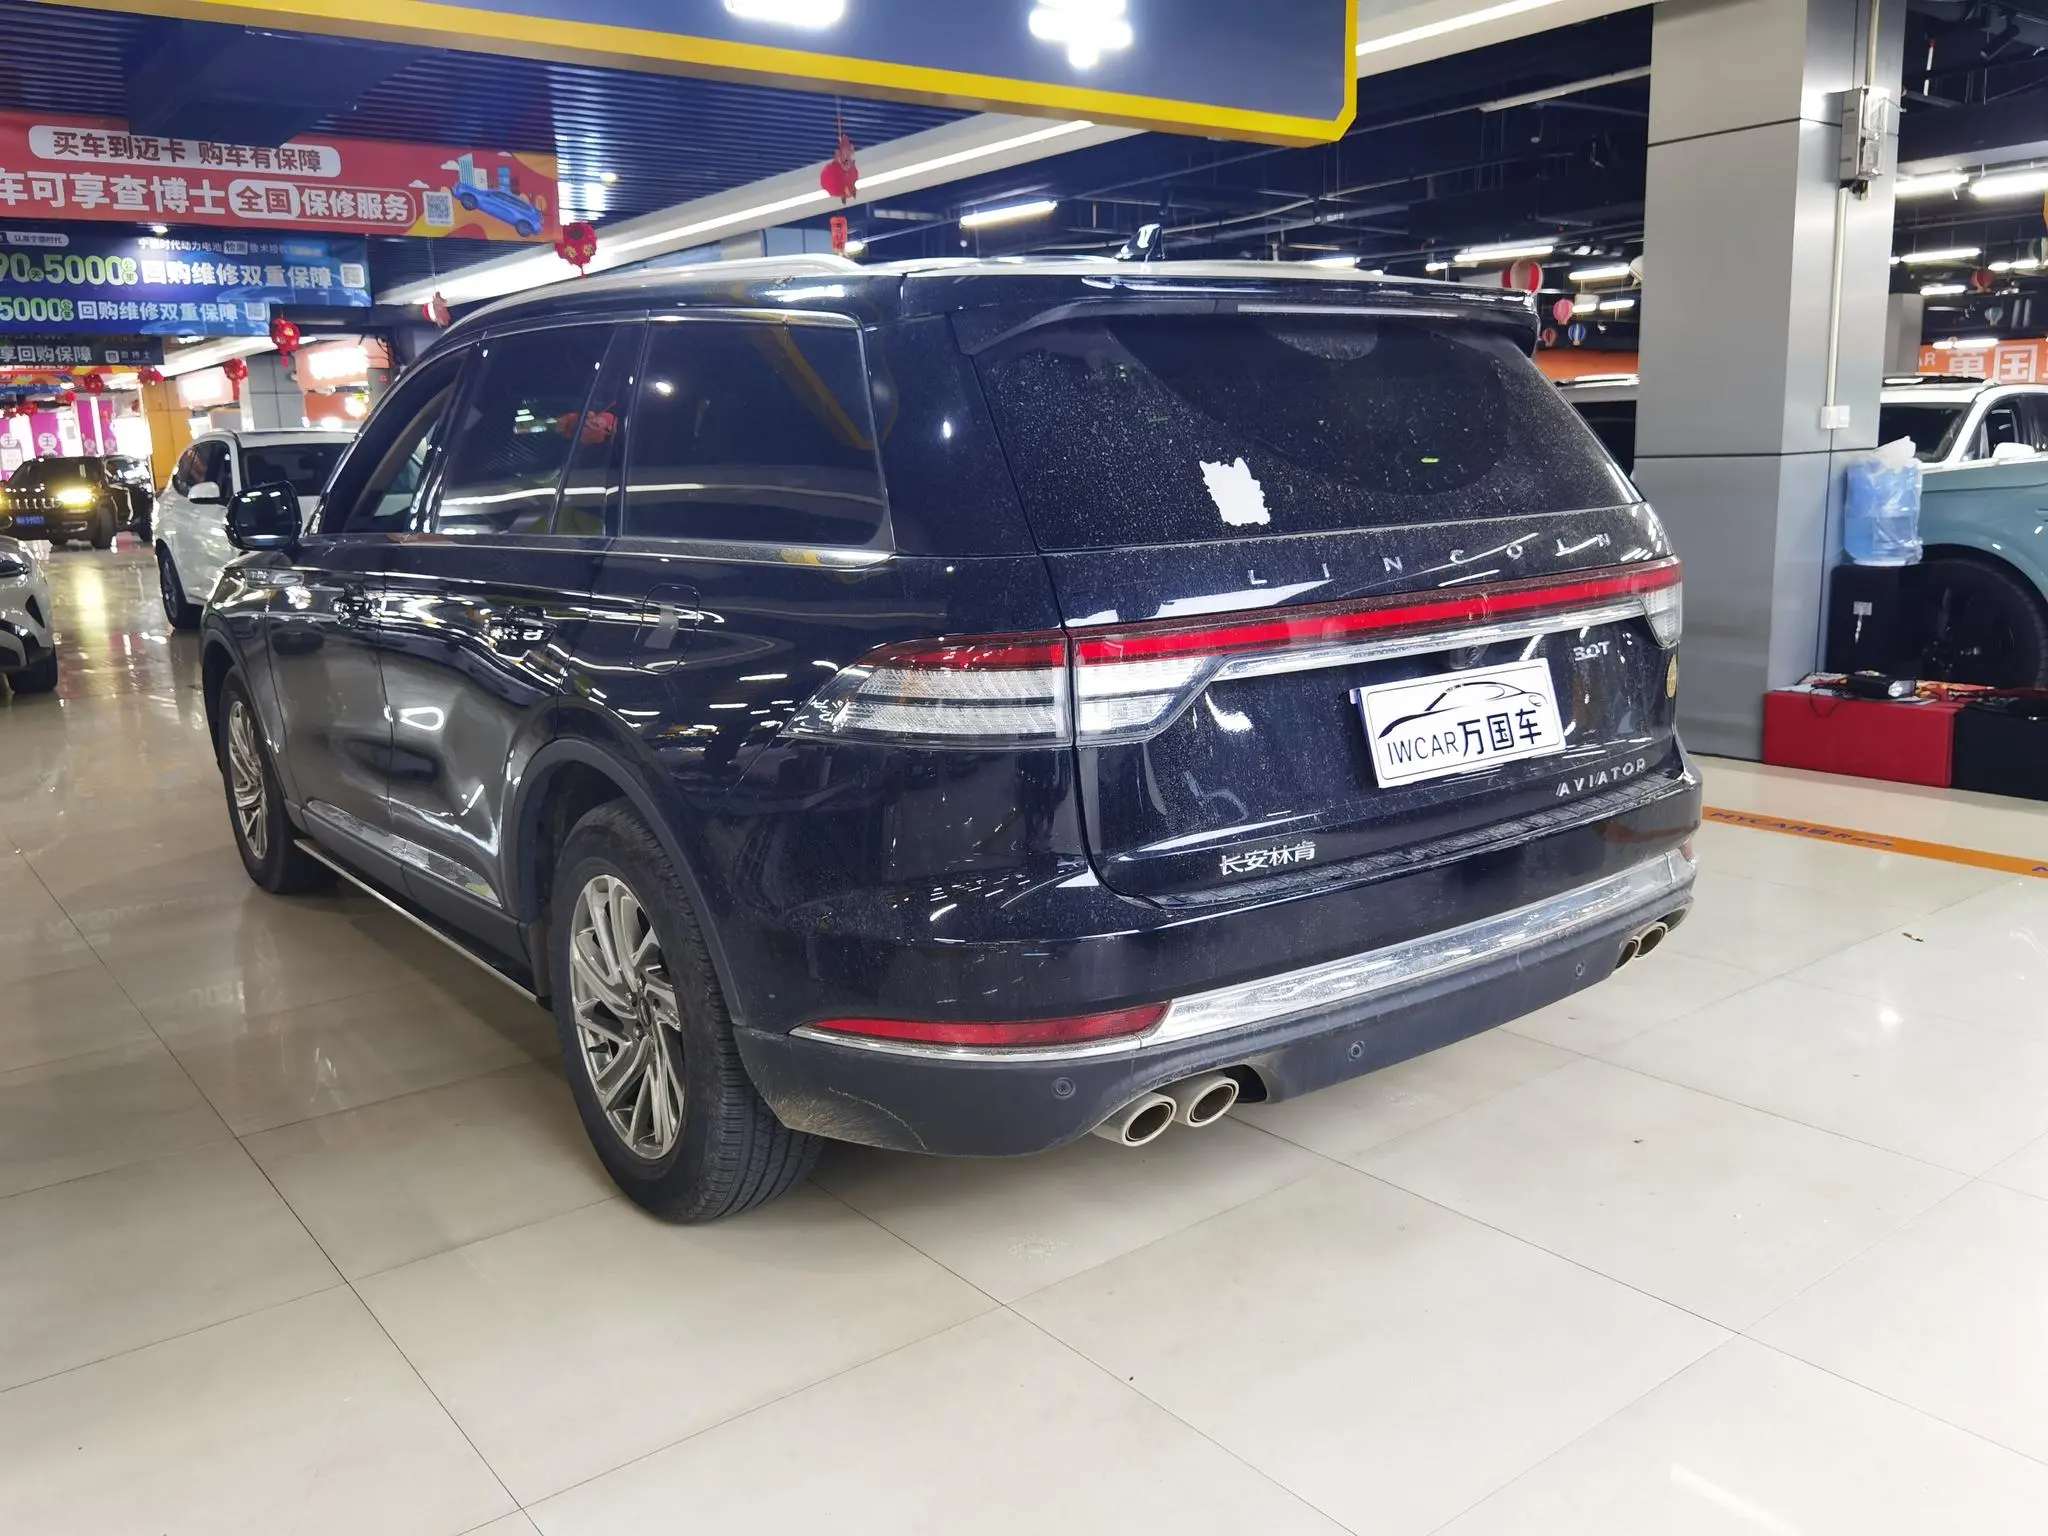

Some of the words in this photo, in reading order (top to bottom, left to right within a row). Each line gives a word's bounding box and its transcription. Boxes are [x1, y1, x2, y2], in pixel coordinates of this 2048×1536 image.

[53, 131, 186, 163] 买车到迈卡
[198, 140, 322, 172] 购车有保障
[1249, 533, 1610, 585] LINCOLN
[1555, 757, 1646, 797] AVIATOR
[1219, 840, 1316, 875] 长安林肯
